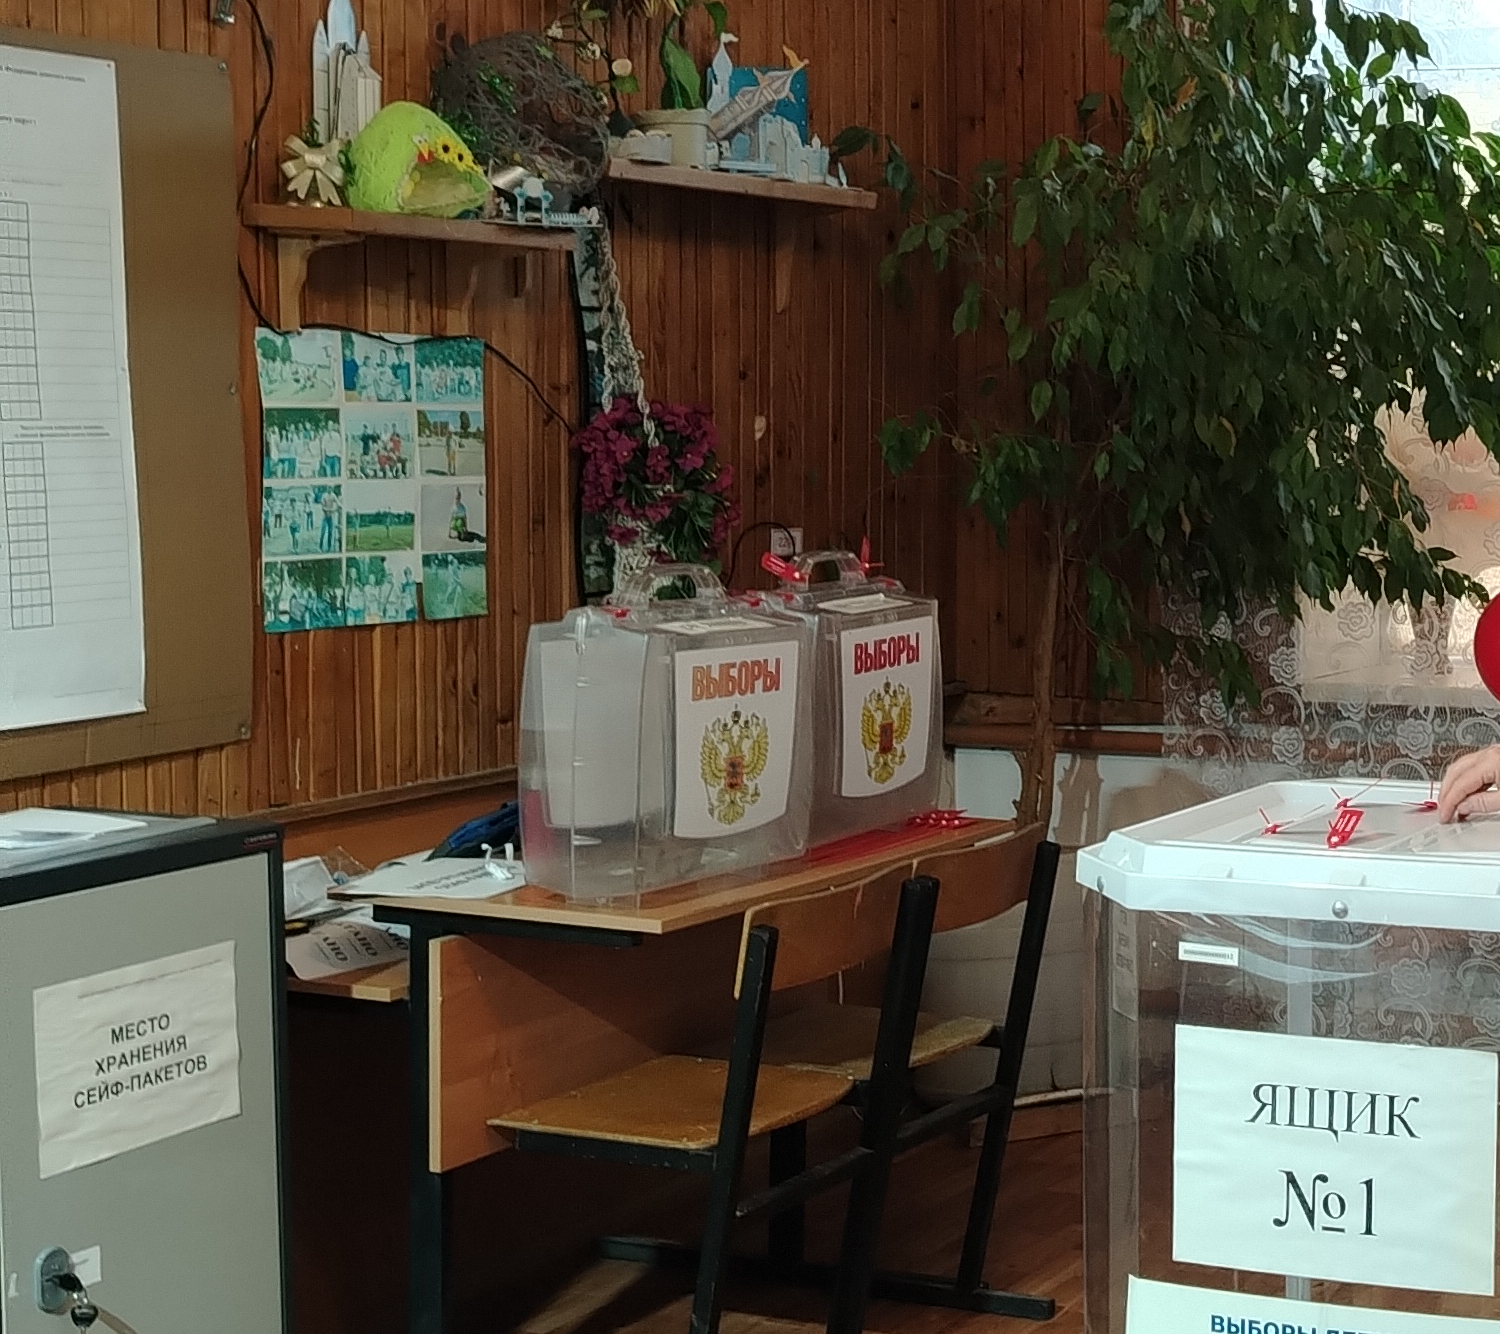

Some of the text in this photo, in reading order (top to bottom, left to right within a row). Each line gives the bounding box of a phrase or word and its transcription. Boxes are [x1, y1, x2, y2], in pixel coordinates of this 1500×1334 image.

[854, 632, 920, 675] ВЫБОРЫ
[692, 658, 781, 701] ВЫБОРЫ
[111, 1014, 170, 1044] МЕСТО
[95, 1035, 188, 1076] ХРАНЕНИЯ
[74, 1055, 208, 1108] СЕЙФ-ПАКЕТОВ
[1244, 1083, 1421, 1141] ЯЩИК
